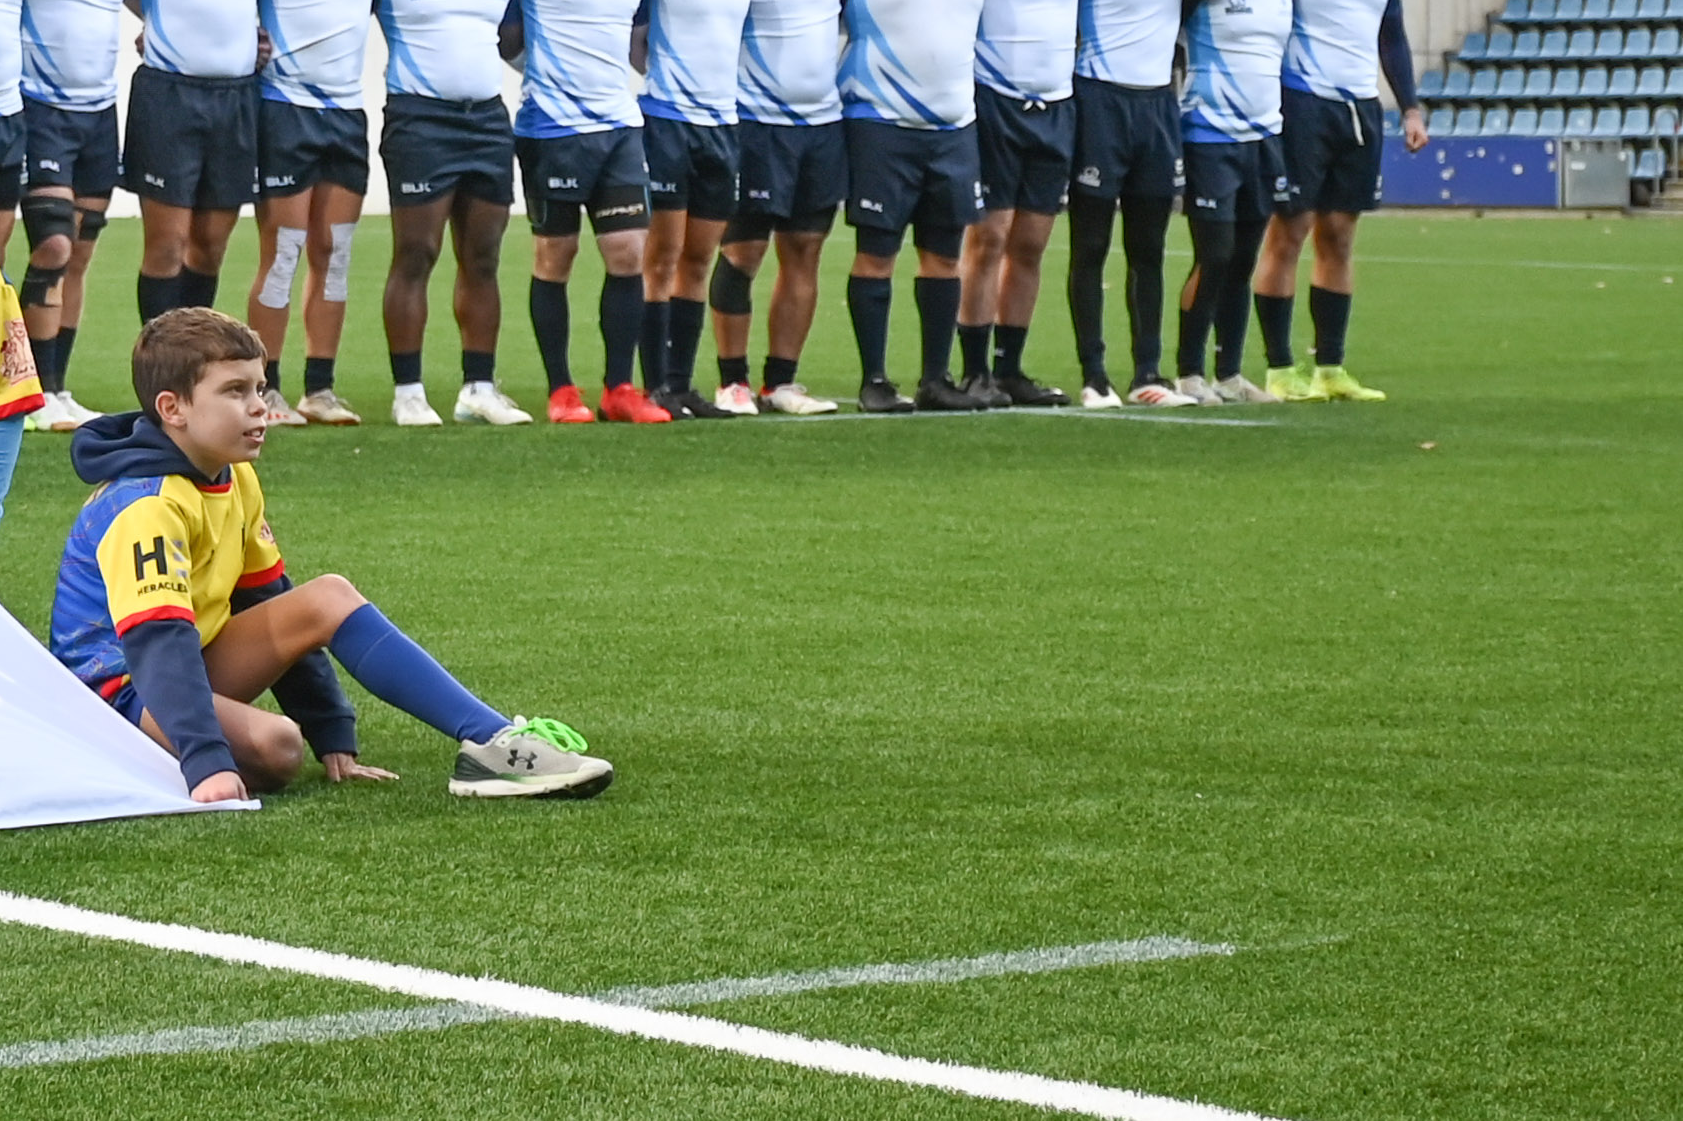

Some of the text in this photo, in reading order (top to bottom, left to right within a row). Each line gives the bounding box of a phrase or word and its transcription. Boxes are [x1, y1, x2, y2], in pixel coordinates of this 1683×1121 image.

[265, 175, 295, 187] BLK
[548, 177, 578, 188] BLK
[401, 182, 431, 193] BLK
